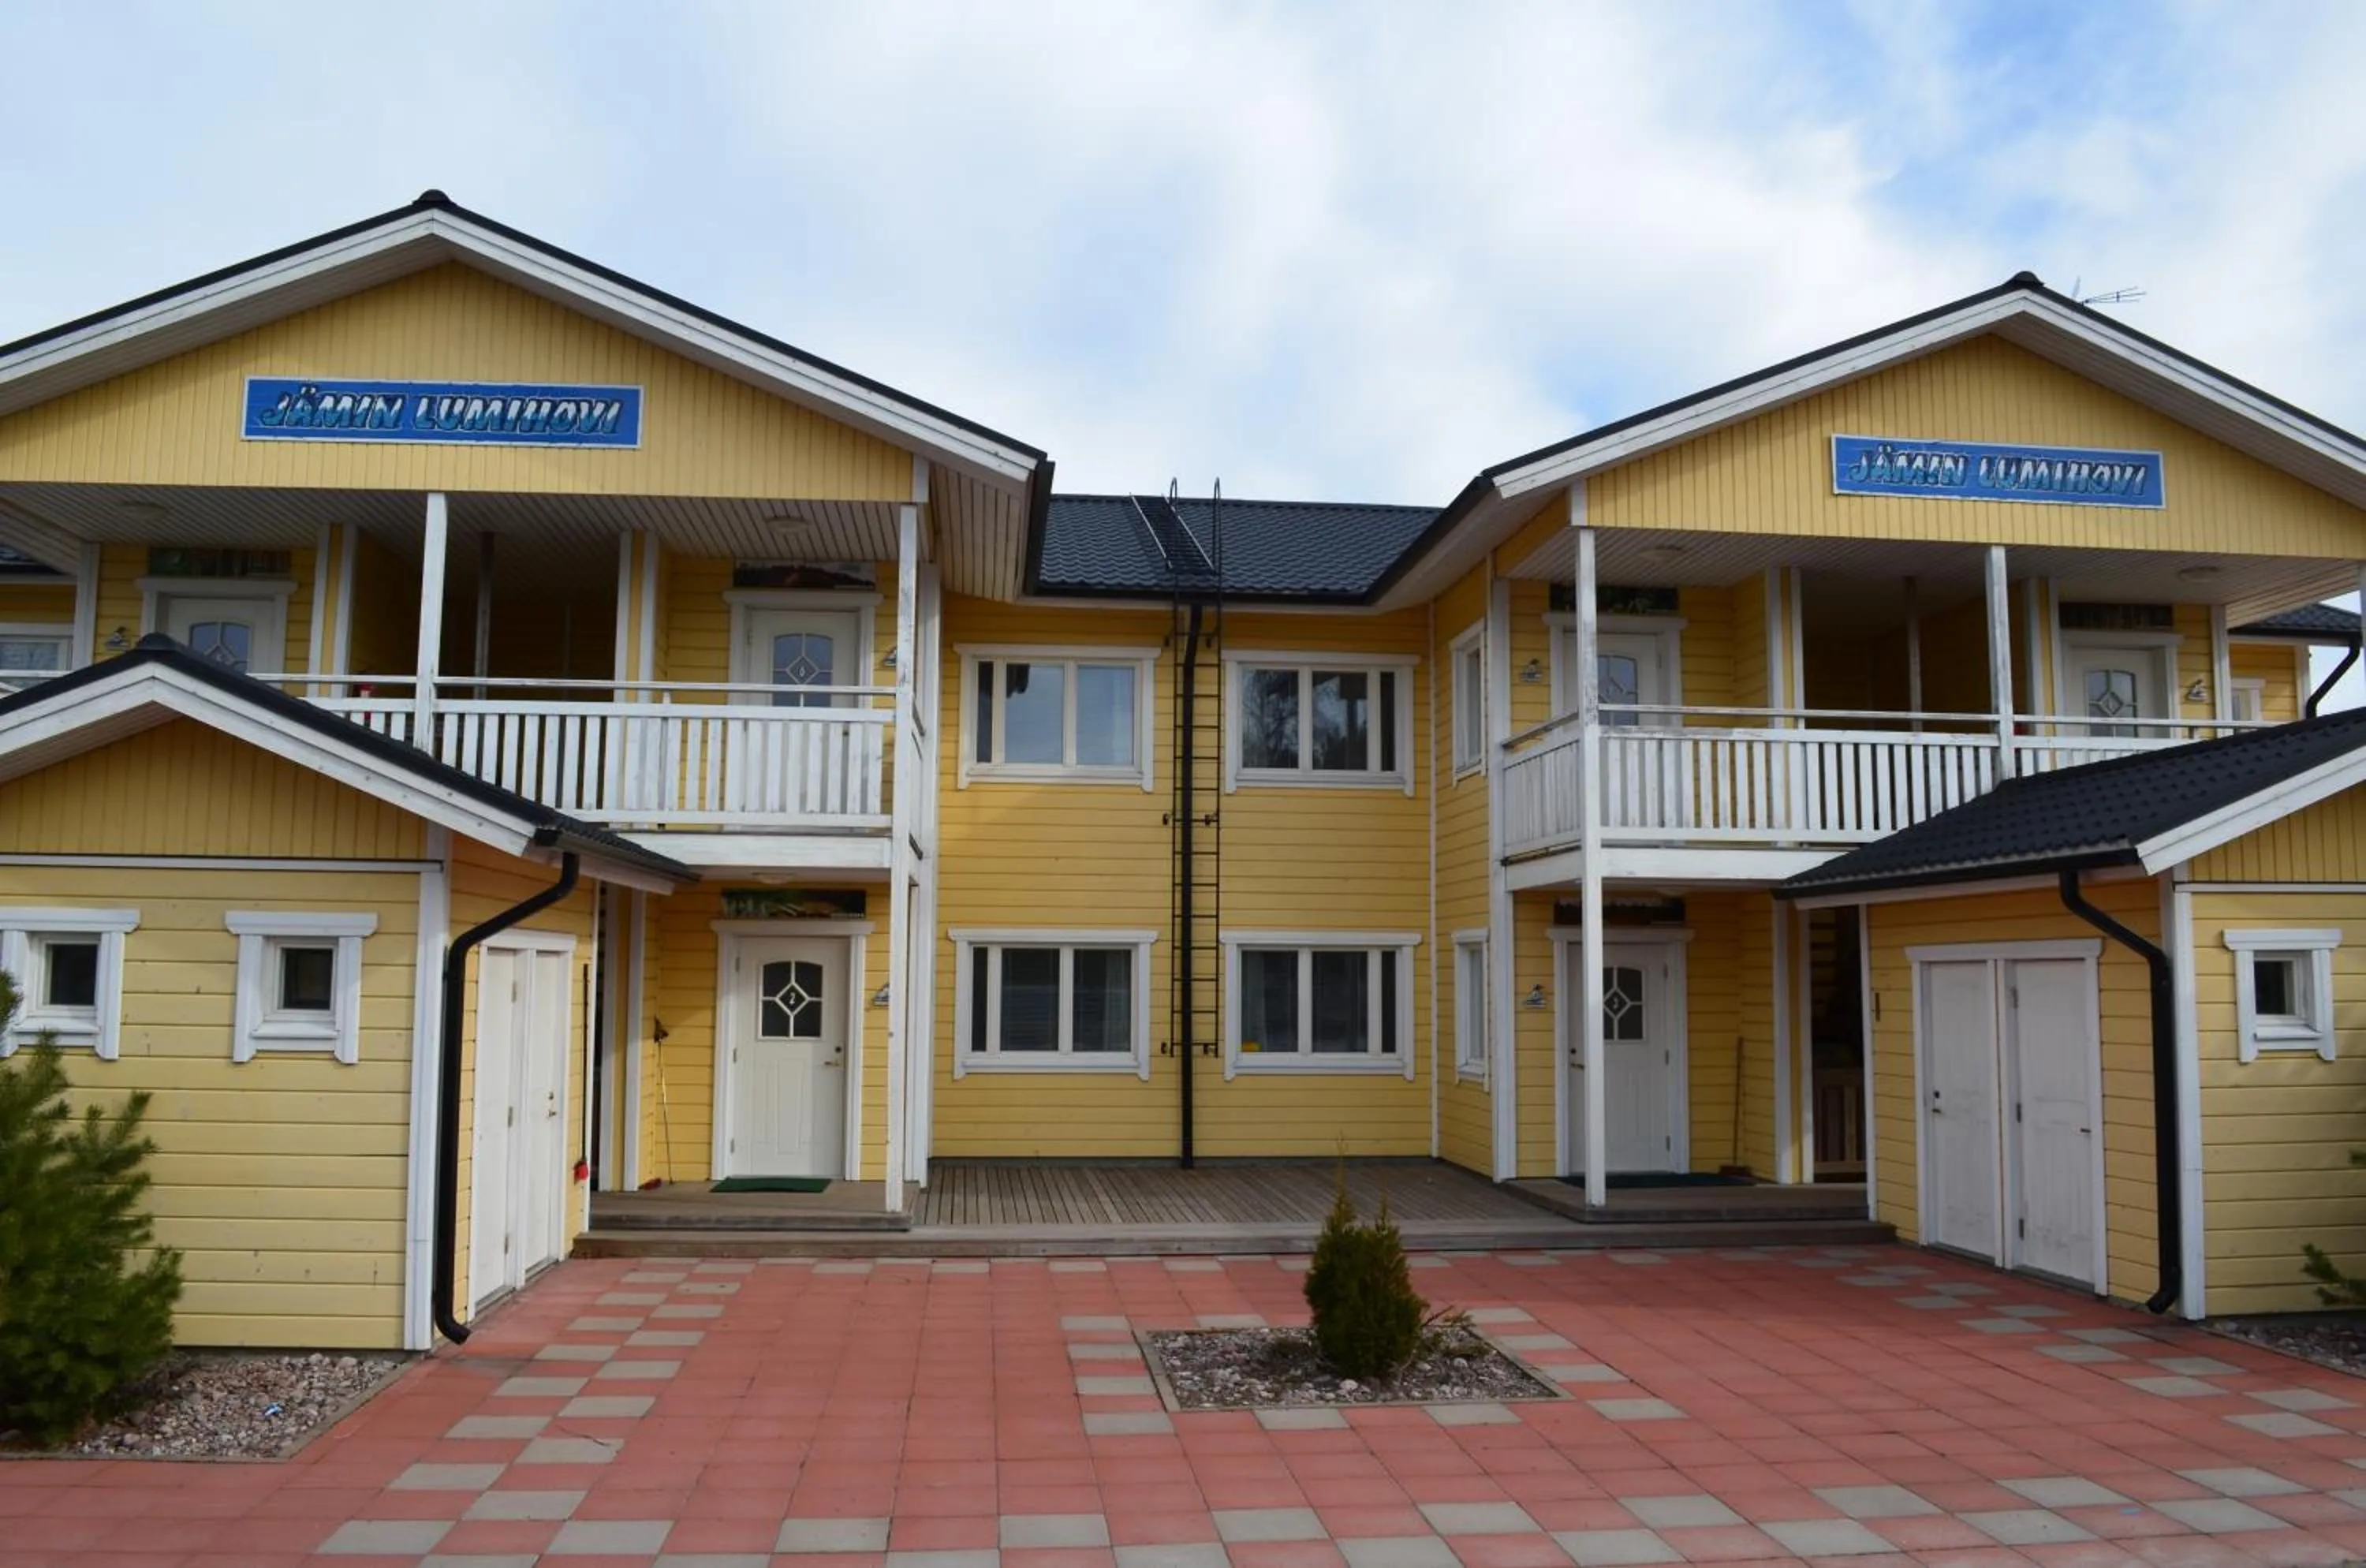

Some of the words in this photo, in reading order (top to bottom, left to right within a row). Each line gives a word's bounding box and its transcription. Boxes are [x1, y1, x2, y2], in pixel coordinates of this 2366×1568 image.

[262, 383, 401, 430] JÄMIN
[414, 393, 623, 434] LUMIHOVI
[1849, 444, 1968, 487] JÄMIN
[1980, 454, 2148, 496] LUMIHOVI
[789, 991, 796, 1005] 2
